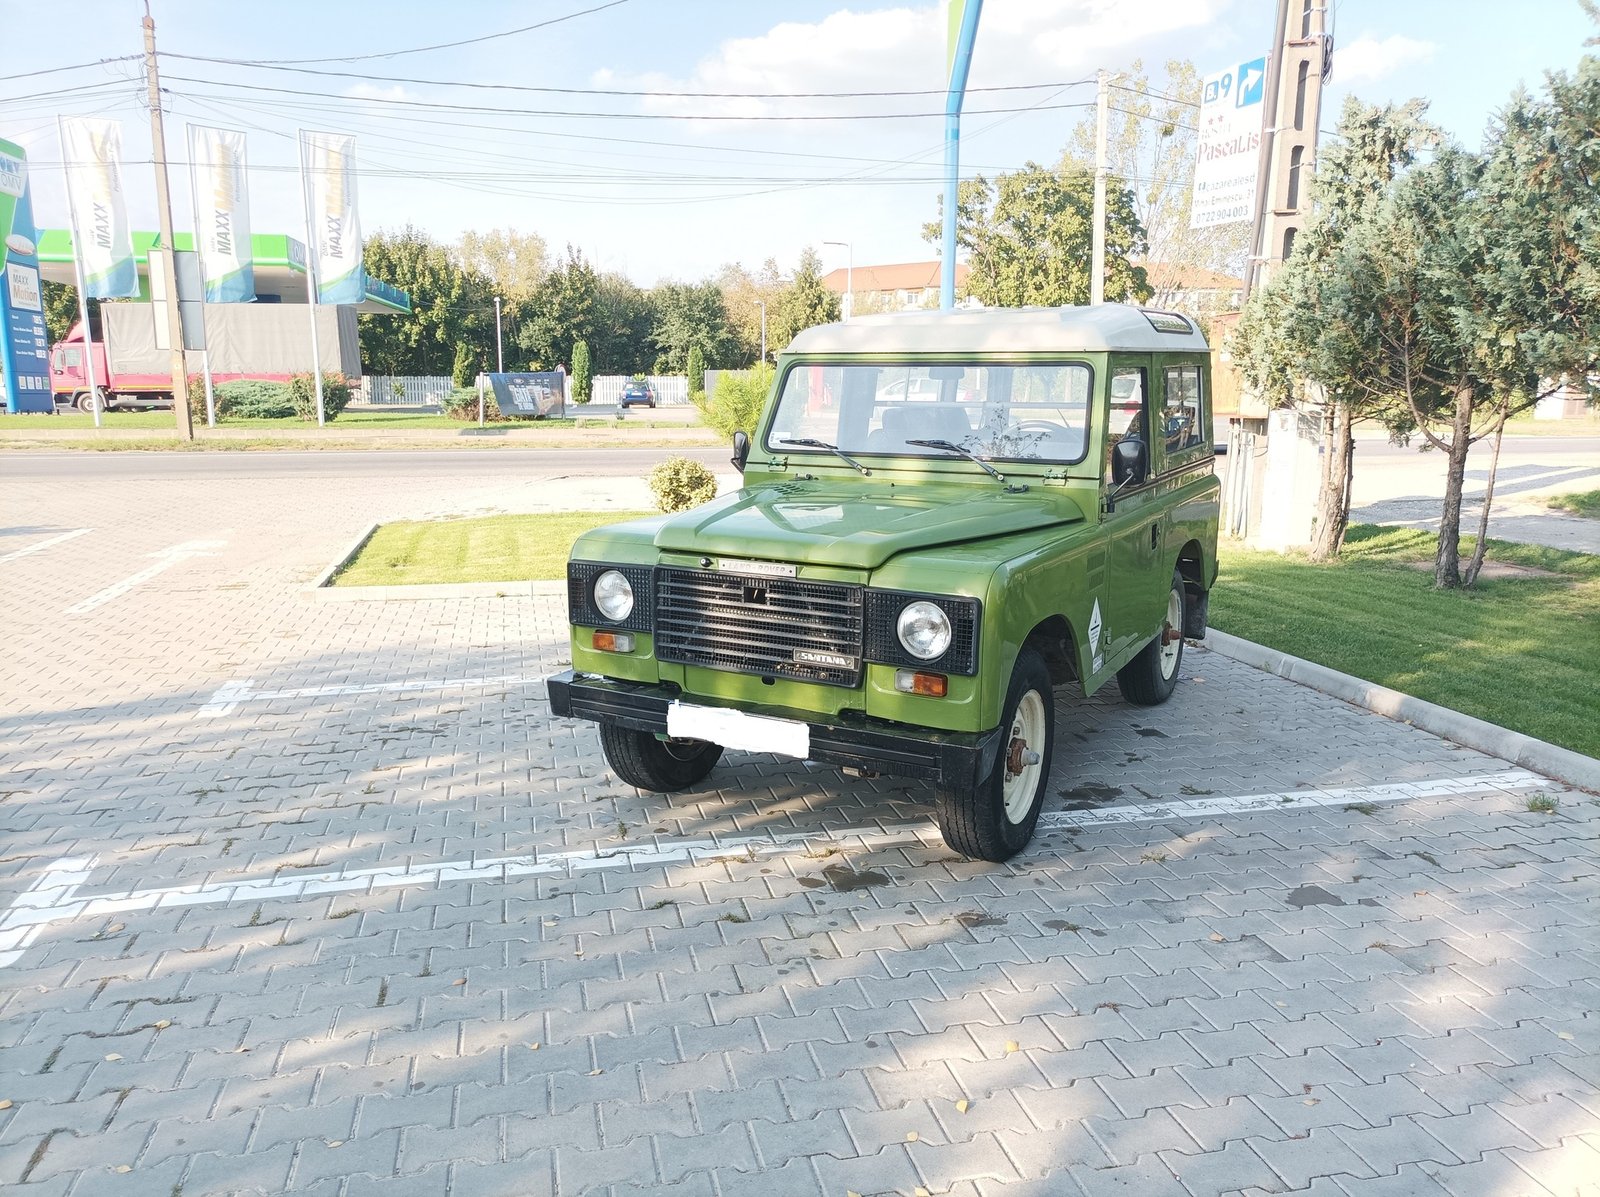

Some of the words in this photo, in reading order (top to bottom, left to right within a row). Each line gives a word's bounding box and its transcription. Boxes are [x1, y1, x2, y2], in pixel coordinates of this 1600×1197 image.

[1221, 73, 1232, 98] 9
[93, 202, 111, 249] MAXX
[215, 209, 232, 255] MAXX
[327, 215, 343, 259] MAXX
[13, 273, 29, 285] MAXX
[800, 652, 847, 665] SANTANA
